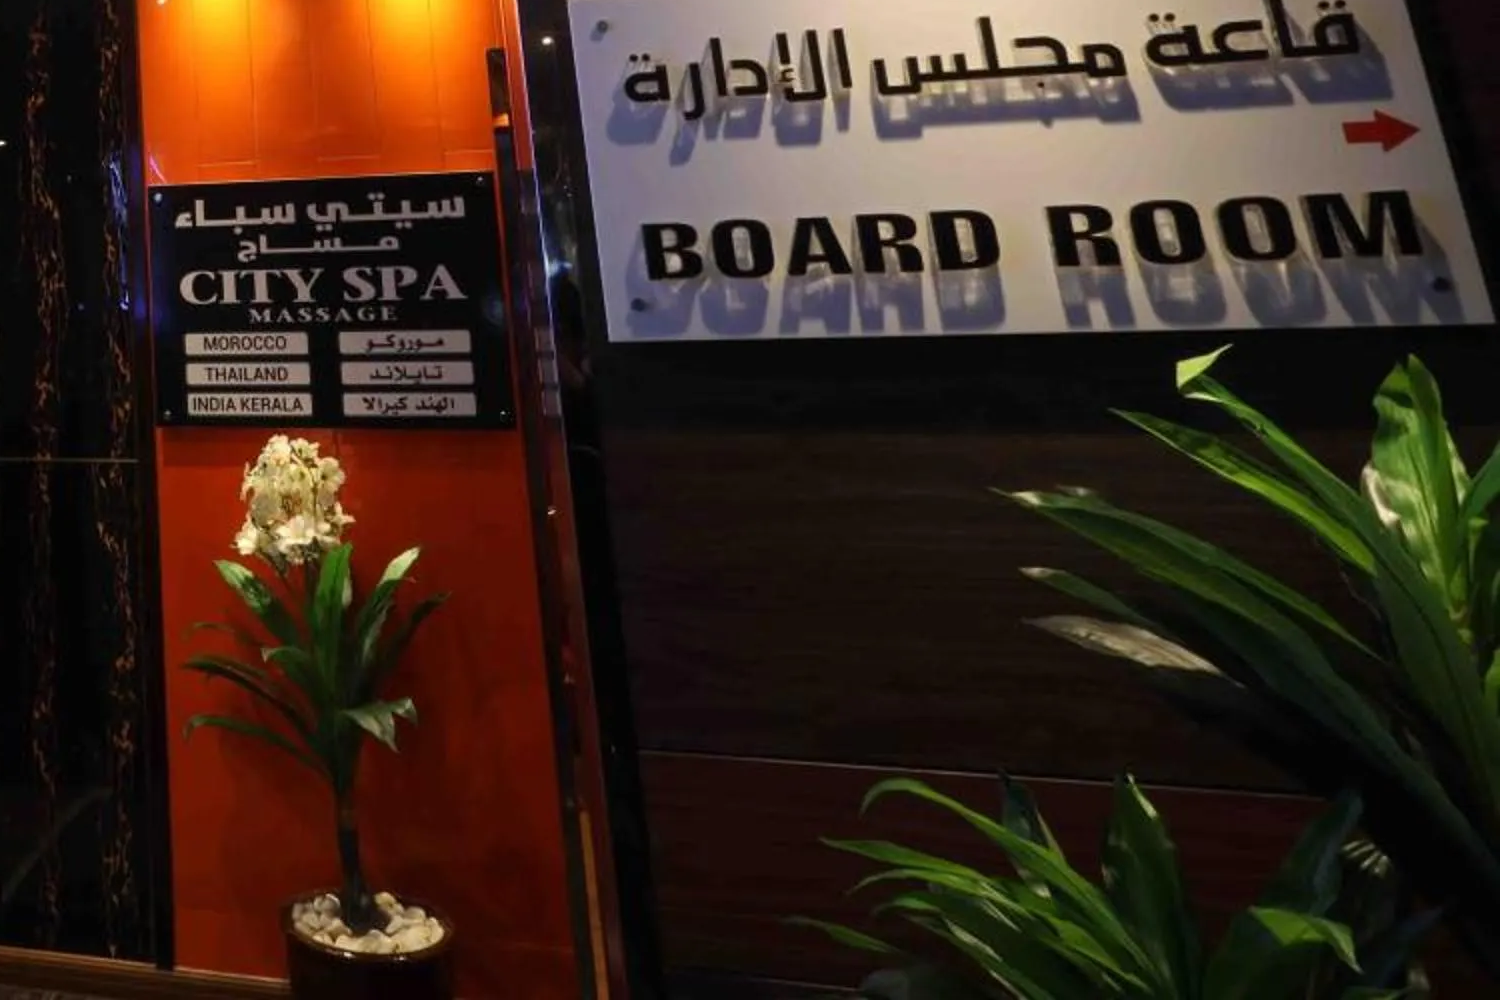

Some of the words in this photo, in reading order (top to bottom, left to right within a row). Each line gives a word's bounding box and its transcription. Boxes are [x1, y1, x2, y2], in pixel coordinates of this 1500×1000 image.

[871, 15, 1127, 97] مجلس
[622, 27, 853, 122] الإدارة
[174, 199, 297, 235] سباء
[306, 191, 466, 231] سيتي
[236, 233, 400, 263] مساج
[640, 208, 1001, 282] BOARD
[1044, 189, 1424, 268] ROOM
[179, 267, 324, 305] CITY
[342, 263, 468, 302] SPA
[249, 305, 399, 325] MASSAGE
[202, 335, 288, 352] MOROCCO
[204, 366, 289, 383] THAILAND
[192, 397, 238, 413] INDIA
[239, 397, 304, 413] KERALA
